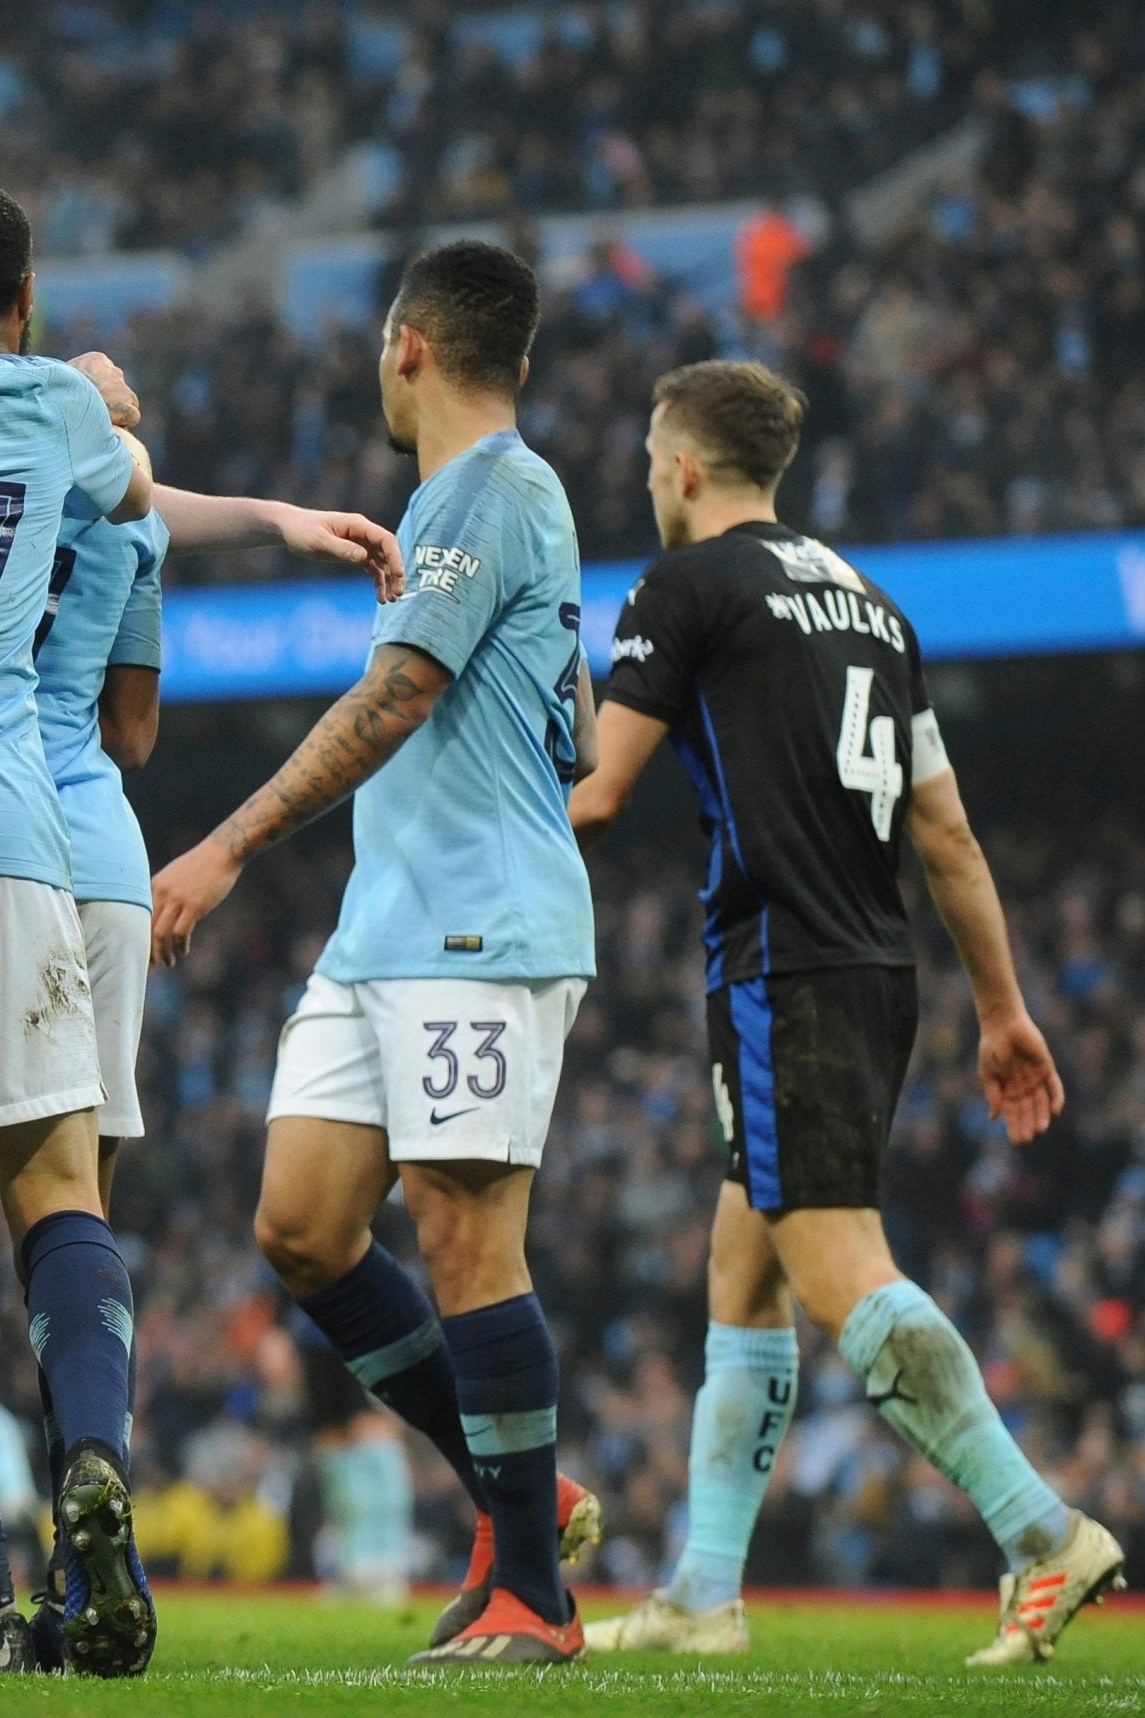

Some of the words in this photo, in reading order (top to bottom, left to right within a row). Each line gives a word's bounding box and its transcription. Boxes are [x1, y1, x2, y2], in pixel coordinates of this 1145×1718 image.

[414, 546, 481, 578] NEXEN
[788, 589, 905, 653] VAULKS
[836, 665, 903, 842] 4
[422, 1021, 507, 1099] 33
